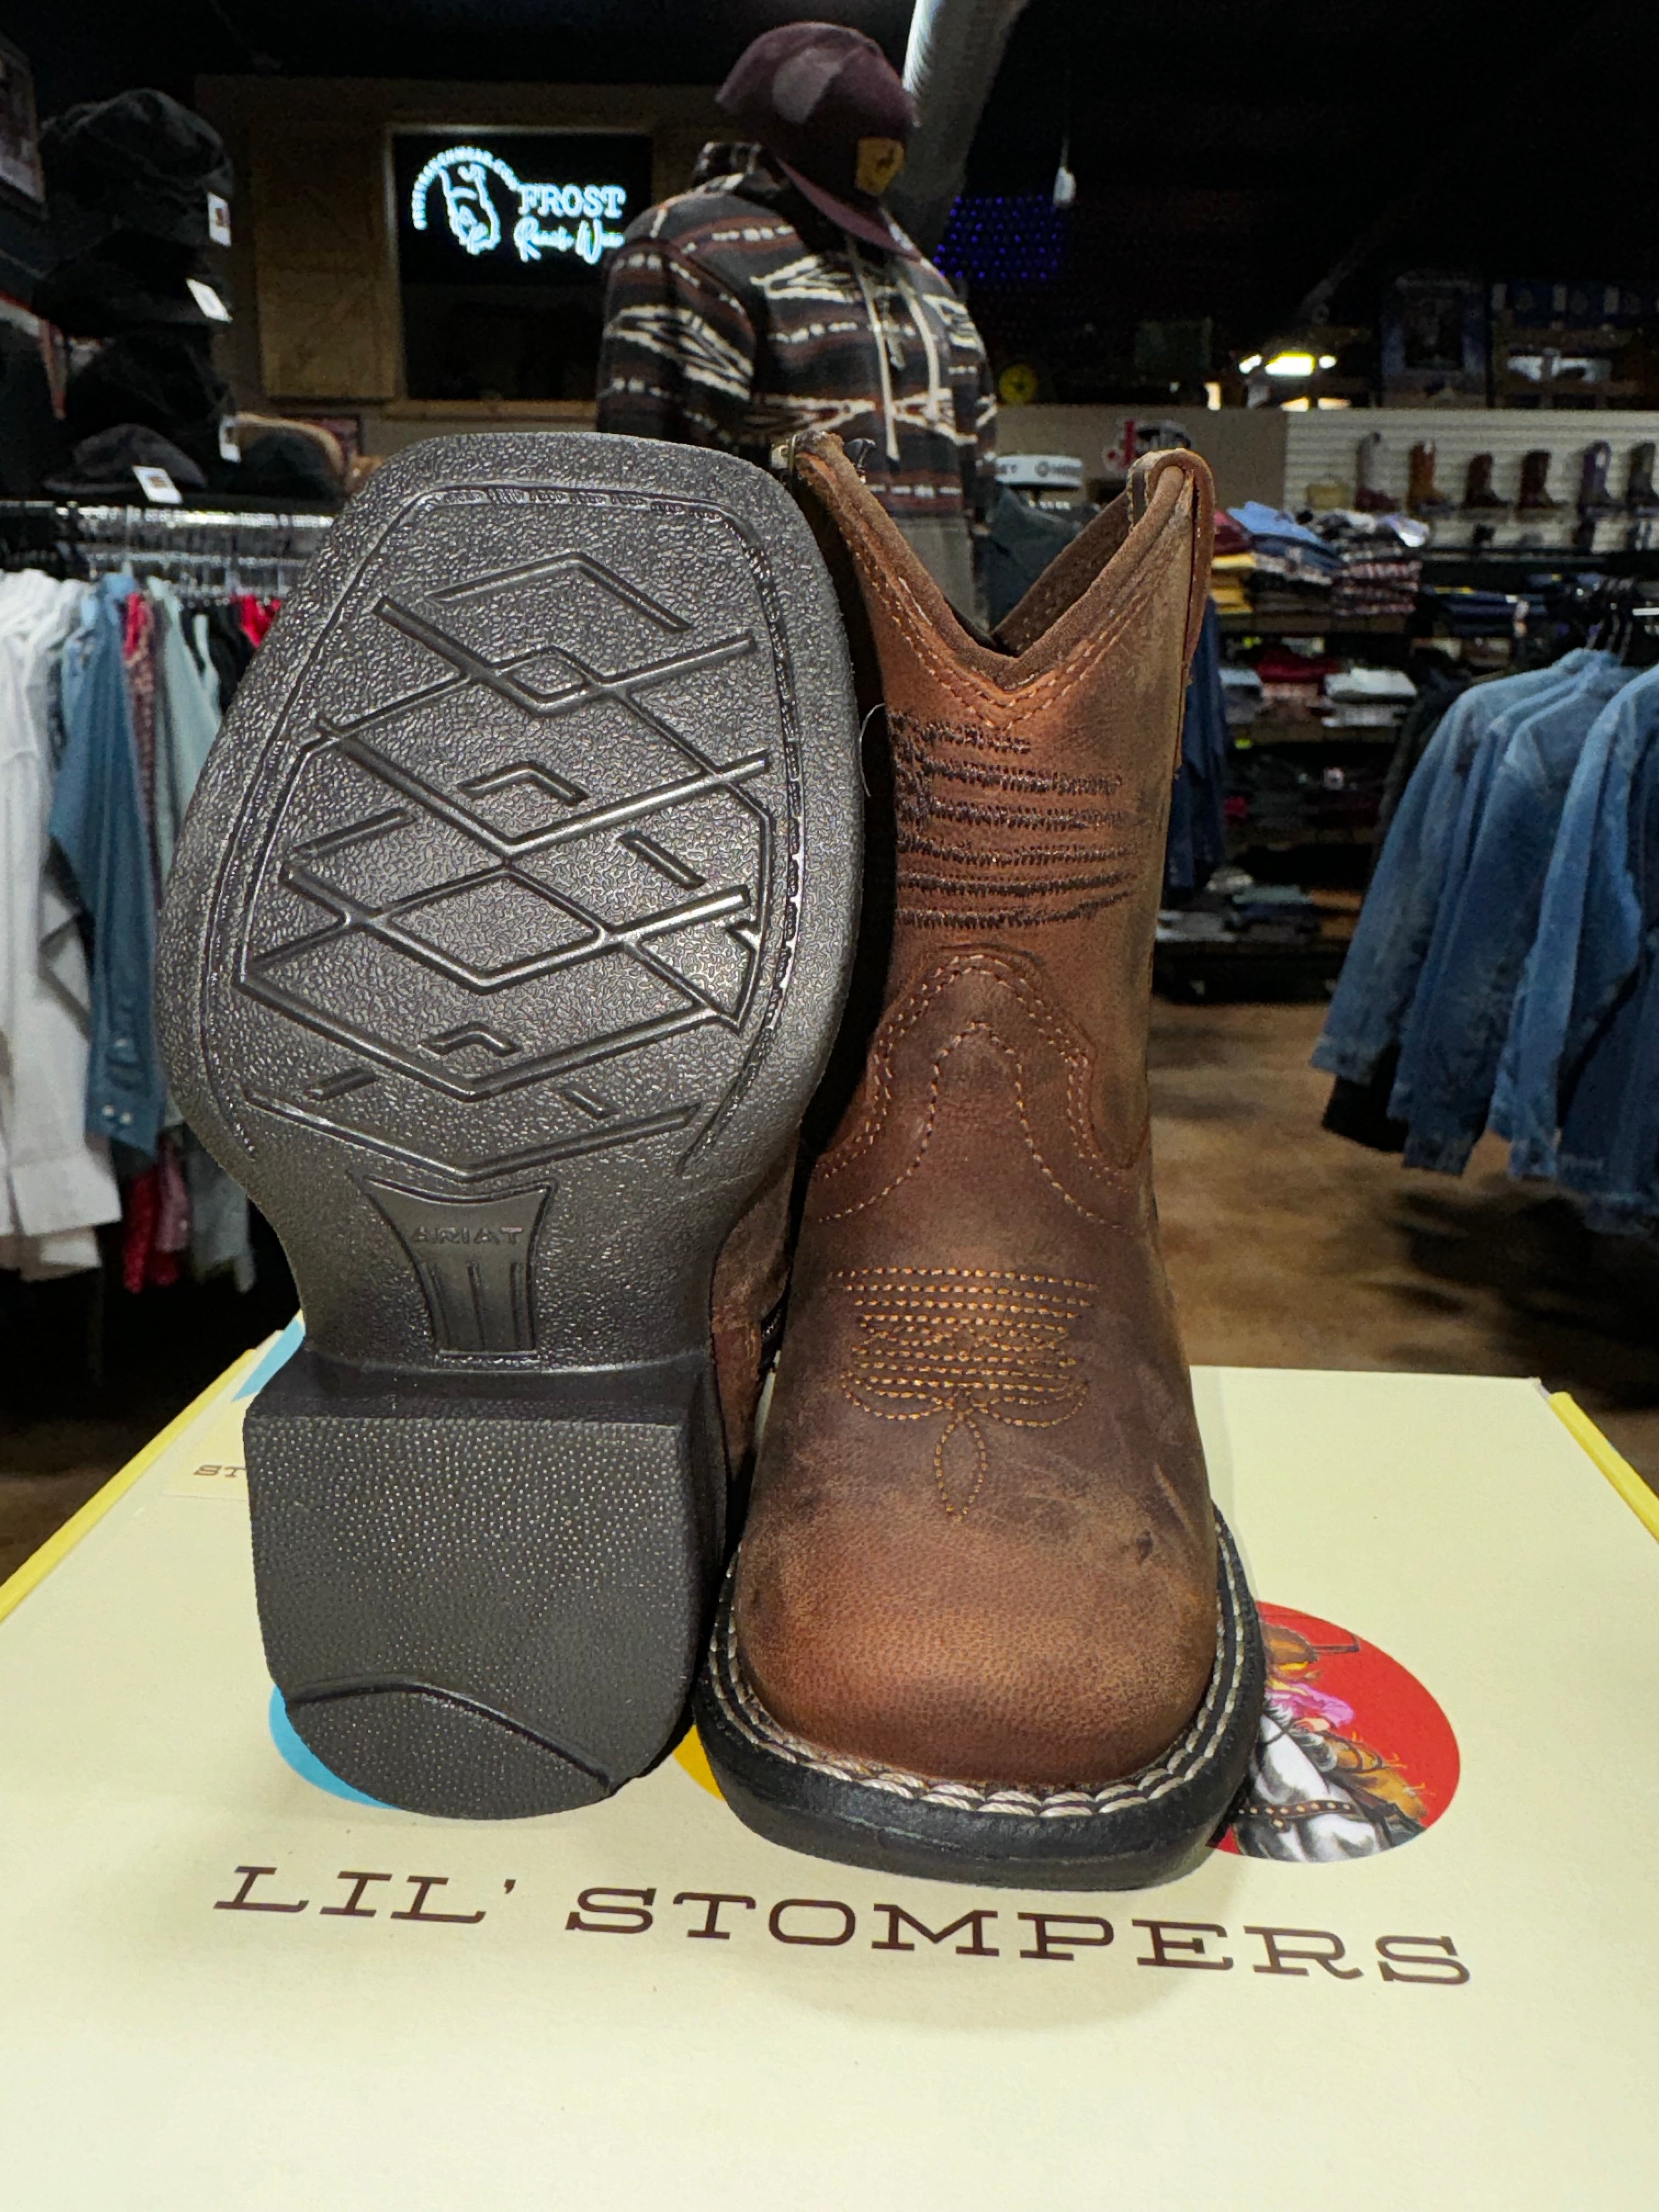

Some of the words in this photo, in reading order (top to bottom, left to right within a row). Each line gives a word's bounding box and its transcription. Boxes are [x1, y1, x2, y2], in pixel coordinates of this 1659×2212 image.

[518, 184, 627, 218] FROST
[414, 1226, 522, 1245] ARIAT
[213, 1865, 517, 1924] LIL'
[565, 1887, 1470, 1985] STOMPERS
